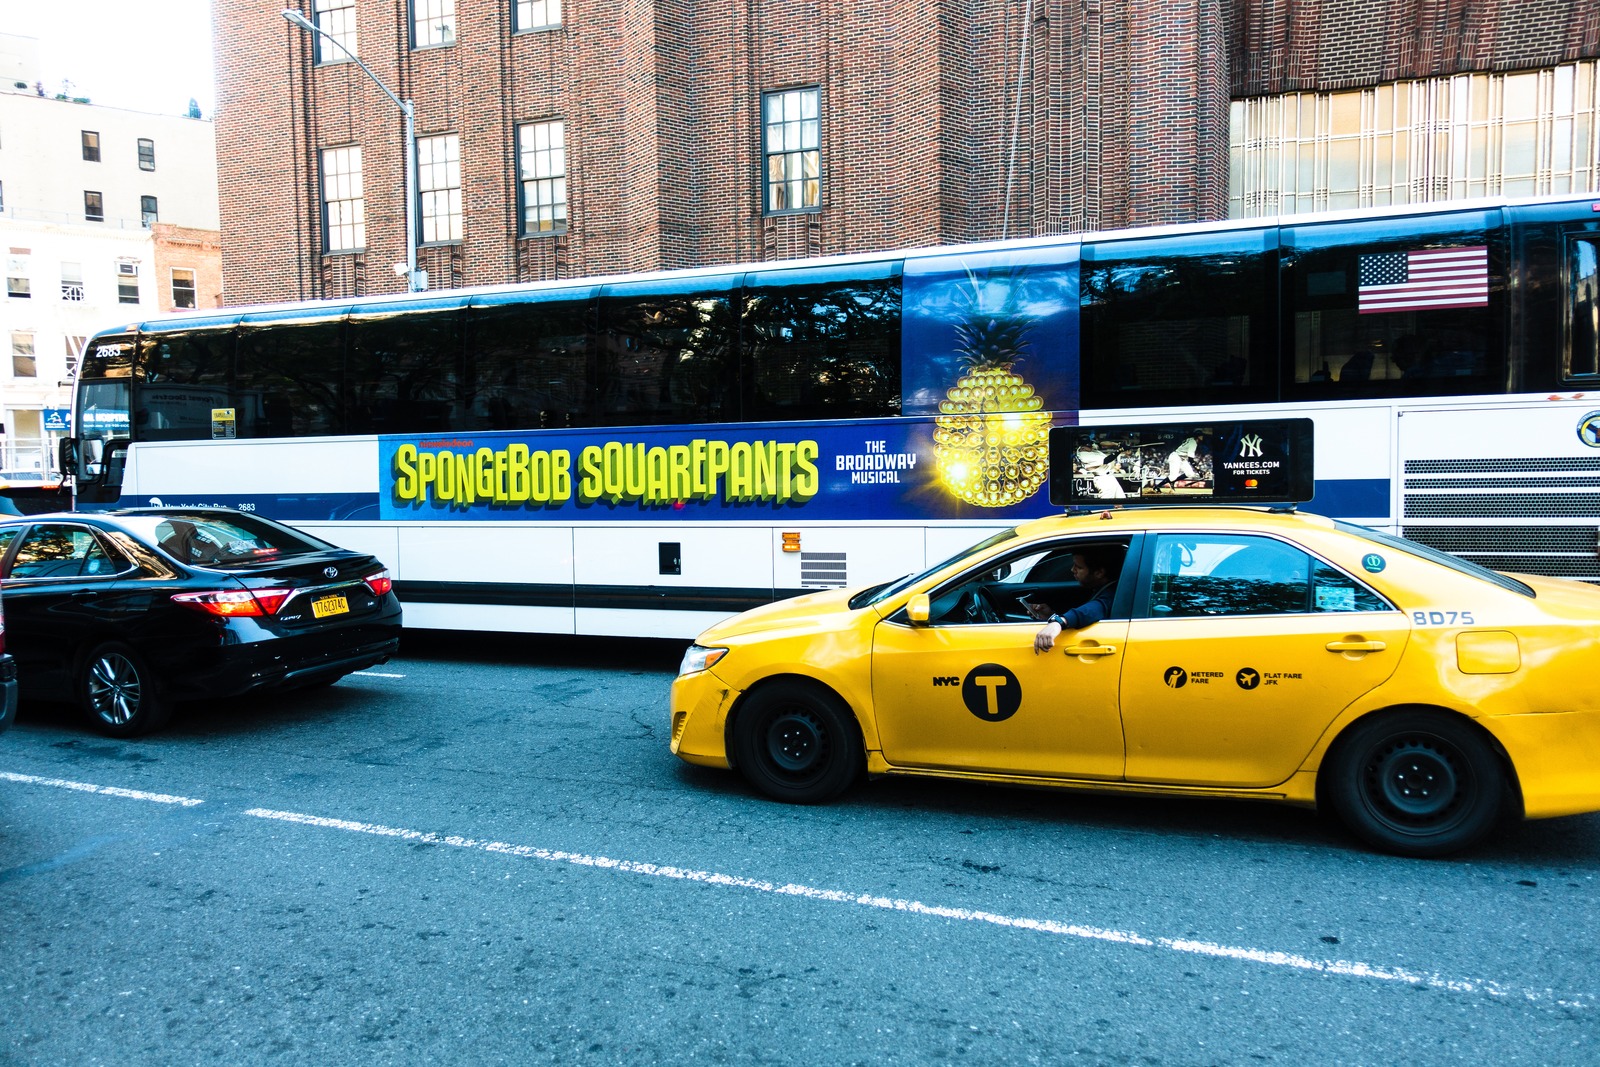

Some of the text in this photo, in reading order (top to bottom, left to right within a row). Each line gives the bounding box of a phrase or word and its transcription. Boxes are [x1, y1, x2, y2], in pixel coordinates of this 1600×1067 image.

[96, 345, 121, 358] 2683
[865, 440, 886, 453] THE
[835, 453, 917, 471] BROADWAY
[1223, 461, 1280, 470] YANKEES.COM
[395, 439, 820, 506] SPONGEBOB SQUAREPANTS
[851, 470, 901, 484] MUSICAL
[238, 503, 256, 512] 2683
[315, 598, 346, 613] T762374C
[1413, 611, 1475, 626] 8D75
[932, 675, 1008, 715] NYC T
